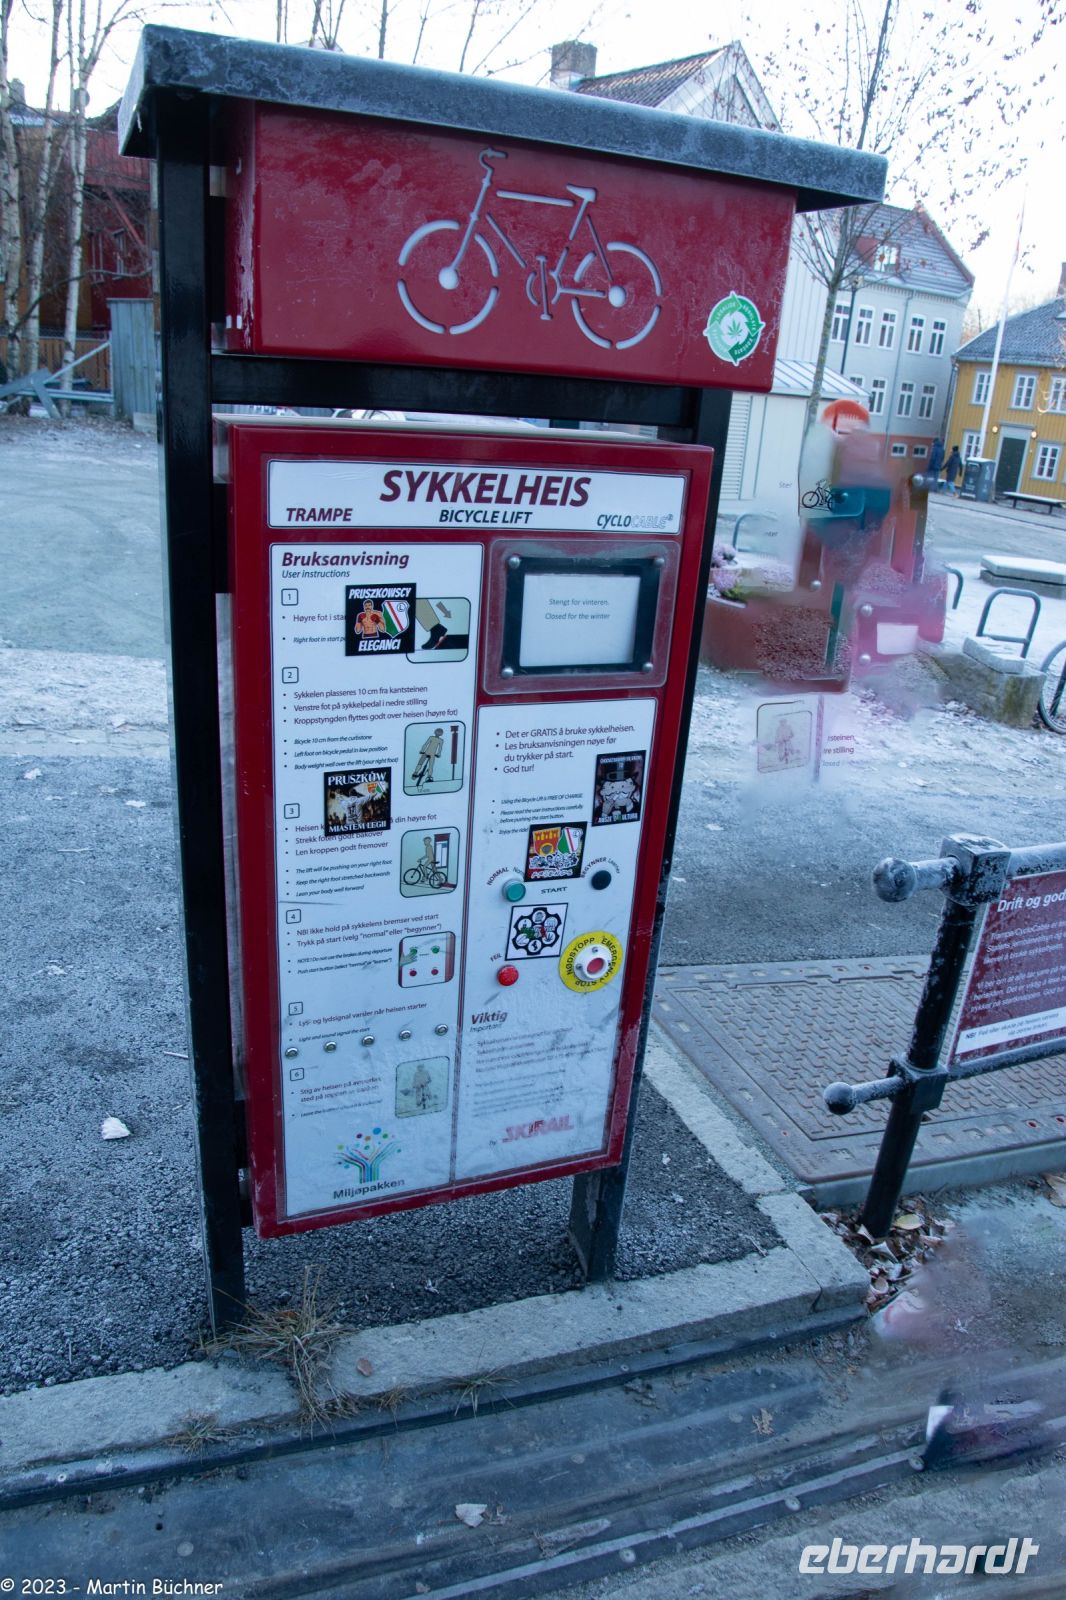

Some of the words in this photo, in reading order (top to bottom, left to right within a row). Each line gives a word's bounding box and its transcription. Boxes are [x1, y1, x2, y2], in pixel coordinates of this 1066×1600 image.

[380, 470, 591, 507] SYKKELHEIS
[286, 507, 353, 522] TRAMPE
[439, 510, 500, 523] BICYCLE
[502, 511, 532, 524] LIFT
[282, 552, 409, 570] Bruksanvisning
[282, 569, 301, 579] User
[302, 569, 350, 578] instructions
[349, 587, 411, 599] PRUSZKOWSCY
[549, 598, 569, 606] Stengt
[582, 599, 608, 607] vinteren.
[293, 614, 316, 623] Høyre
[316, 613, 327, 621] fot
[545, 612, 567, 620] Closed
[358, 639, 401, 652] ELEGANCI
[294, 690, 324, 700] Sykkelen
[325, 689, 356, 698] plasseres
[379, 686, 388, 694] fra
[320, 702, 331, 710] fot
[331, 702, 341, 711] på
[341, 700, 381, 710] sykkelpedal
[406, 698, 427, 706] stilling
[294, 715, 347, 725] Kroppstyngden
[348, 714, 368, 722] flyttes
[369, 712, 386, 721] godt
[446, 708, 458, 716] fot)
[505, 730, 520, 738] Det
[530, 727, 557, 737] GRATIS
[558, 727, 563, 735] å
[564, 726, 587, 735] bruke
[587, 724, 635, 735] sykkelheisen.
[504, 742, 517, 750] Les
[518, 739, 585, 749] bruksanvisningen
[586, 738, 605, 746] nøye
[606, 736, 616, 744] før
[504, 753, 515, 762] du
[516, 752, 543, 762] trykker
[543, 750, 554, 760] på
[503, 764, 519, 773] God
[521, 763, 534, 772] tur!
[295, 824, 319, 832] Heisen
[329, 823, 365, 832] MIASTEM
[367, 821, 386, 829] LEGII
[339, 844, 357, 852] godt
[487, 867, 509, 885] NORMAL
[997, 897, 1023, 912] Drift
[1025, 896, 1039, 908] og
[1043, 889, 1066, 907] god
[297, 939, 315, 947] Trykk
[315, 937, 324, 946] på
[359, 929, 388, 938] "normal"
[403, 923, 442, 934] "begynner")
[566, 938, 595, 975] NØDSTOPP
[601, 938, 617, 983] EMERGENCY
[472, 1011, 507, 1024] Viktig
[334, 1179, 405, 1199] Miljøpakken
